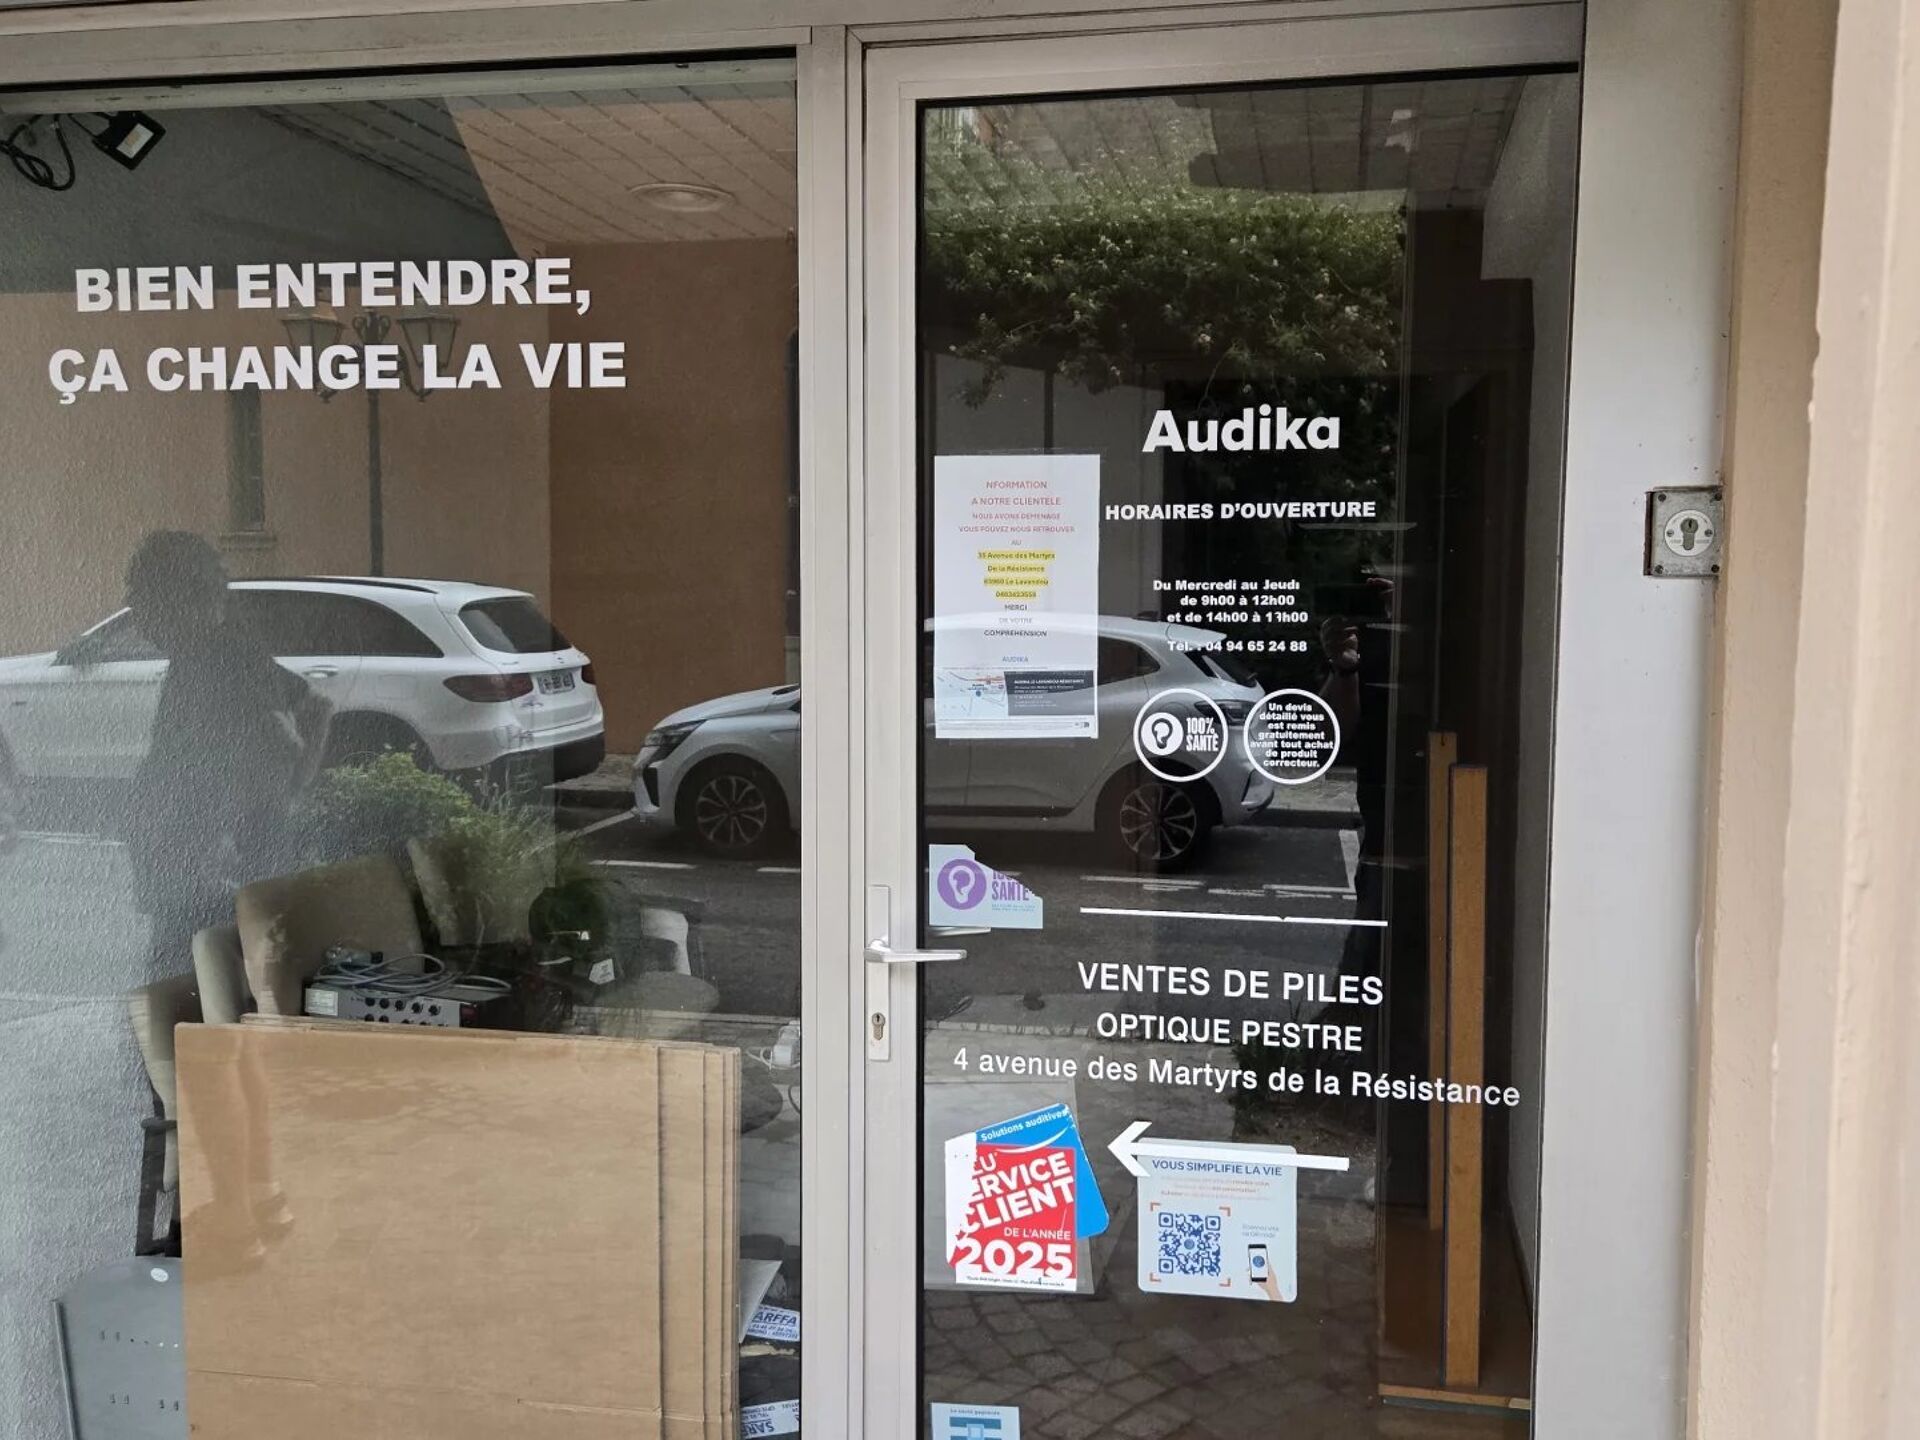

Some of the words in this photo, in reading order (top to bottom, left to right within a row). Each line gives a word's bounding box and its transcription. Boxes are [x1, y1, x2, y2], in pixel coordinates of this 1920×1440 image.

[75, 265, 214, 313] BIEN
[236, 257, 591, 316] ENTENDRE,
[48, 348, 128, 405] ÇA
[146, 343, 400, 391] CHANGE
[422, 343, 502, 390] LA
[520, 341, 627, 389] VIE
[1142, 403, 1340, 452] Audika
[980, 497, 1011, 506] NOTRE
[1105, 503, 1214, 520] HORAIRES
[1220, 501, 1376, 519] D'OUVERTURE
[1014, 551, 1027, 559] des
[1028, 551, 1056, 560] Martyrs
[1153, 580, 1171, 590] Du
[1175, 579, 1236, 590] Mercredi
[1241, 582, 1257, 590] au
[1180, 595, 1198, 606] de
[1201, 595, 1235, 606] 9h00
[1239, 594, 1248, 606] à
[1252, 595, 1295, 606] 12h00
[1167, 613, 1181, 623] et
[1184, 612, 1201, 623] de
[1206, 612, 1248, 623] 14h00
[1252, 611, 1261, 623] à
[1205, 640, 1223, 652] 04
[1226, 640, 1244, 652] 94
[1247, 640, 1264, 652] 65
[1268, 640, 1286, 652] 24
[1290, 640, 1308, 652] 88
[1268, 703, 1283, 711] Un
[1285, 703, 1313, 711] devis
[1186, 717, 1216, 734] 100%
[1267, 722, 1285, 730] est
[1286, 722, 1317, 730] remis
[1186, 733, 1219, 752] SANTÉ
[1258, 731, 1326, 740] gratuitement
[1304, 741, 1334, 749] achat
[1265, 749, 1279, 757] de
[1280, 749, 1318, 759] produit
[1263, 759, 1321, 767] correcteur.
[1077, 961, 1210, 996] VENTES
[1224, 969, 1270, 999] DE
[1282, 971, 1384, 1006] PILES
[1096, 1012, 1231, 1044] OPTIQUE
[1241, 1020, 1363, 1052] PESTRE
[954, 1047, 969, 1071] 4
[979, 1053, 1077, 1078] avenue
[1087, 1055, 1138, 1082] des
[1149, 1058, 1258, 1093] Martyrs
[1268, 1066, 1305, 1093] de
[1315, 1069, 1341, 1096] la
[1352, 1070, 1520, 1106] Résistance
[980, 1121, 1025, 1142] Solutions
[1152, 1159, 1185, 1171] VOUS
[1186, 1161, 1243, 1174] SIMPLIFIE
[1245, 1166, 1261, 1176] LA
[1262, 1166, 1283, 1177] VIE
[971, 1151, 1072, 1202] ERVICE
[1004, 1226, 1020, 1238] DE
[956, 1238, 1074, 1279] 2025
